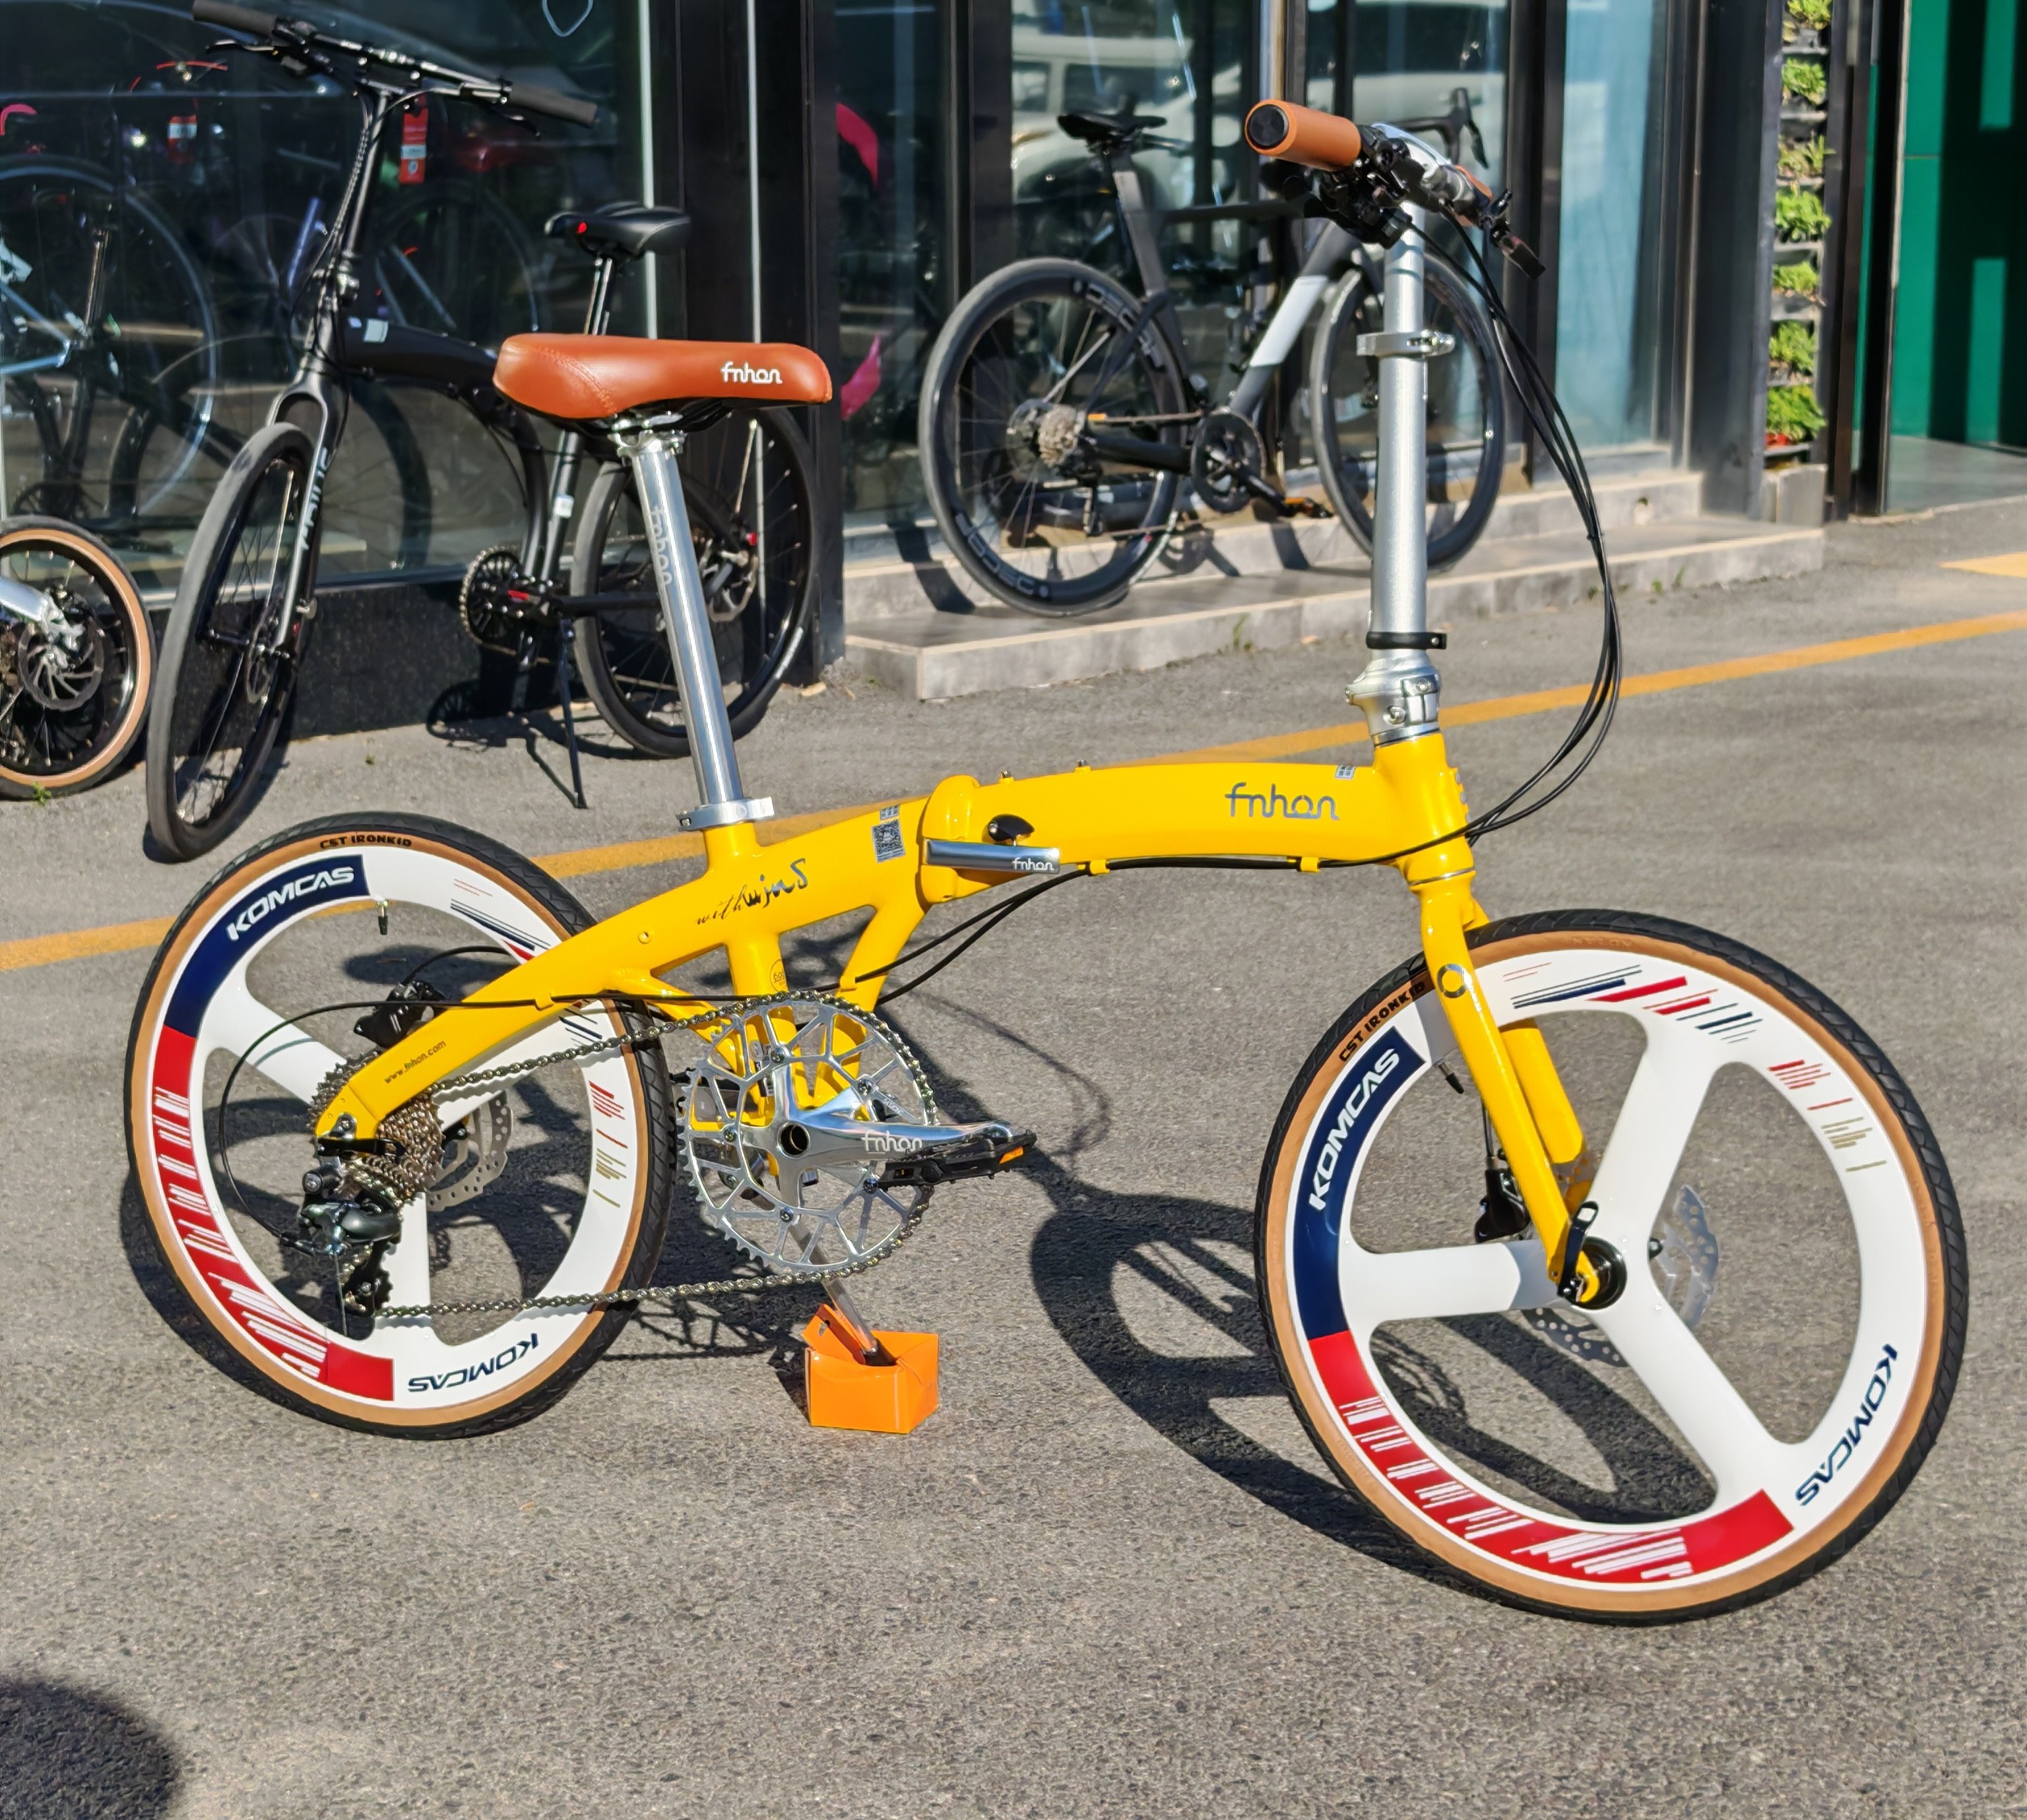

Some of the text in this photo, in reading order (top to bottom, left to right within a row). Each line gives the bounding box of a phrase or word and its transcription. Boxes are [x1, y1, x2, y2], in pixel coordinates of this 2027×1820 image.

[721, 361, 783, 384] fnhon
[1225, 782, 1340, 821] fnhon
[319, 834, 412, 849] CST IRONKID
[1012, 857, 1055, 871] fnhon
[226, 866, 354, 941] KOMCAS
[1339, 982, 1425, 1061] CST IRONKID
[861, 1129, 922, 1152] fnhon
[1309, 1048, 1400, 1210] KOMCAS
[407, 1333, 538, 1392] KOMCAS
[1795, 1343, 1898, 1507] KOMCAS
